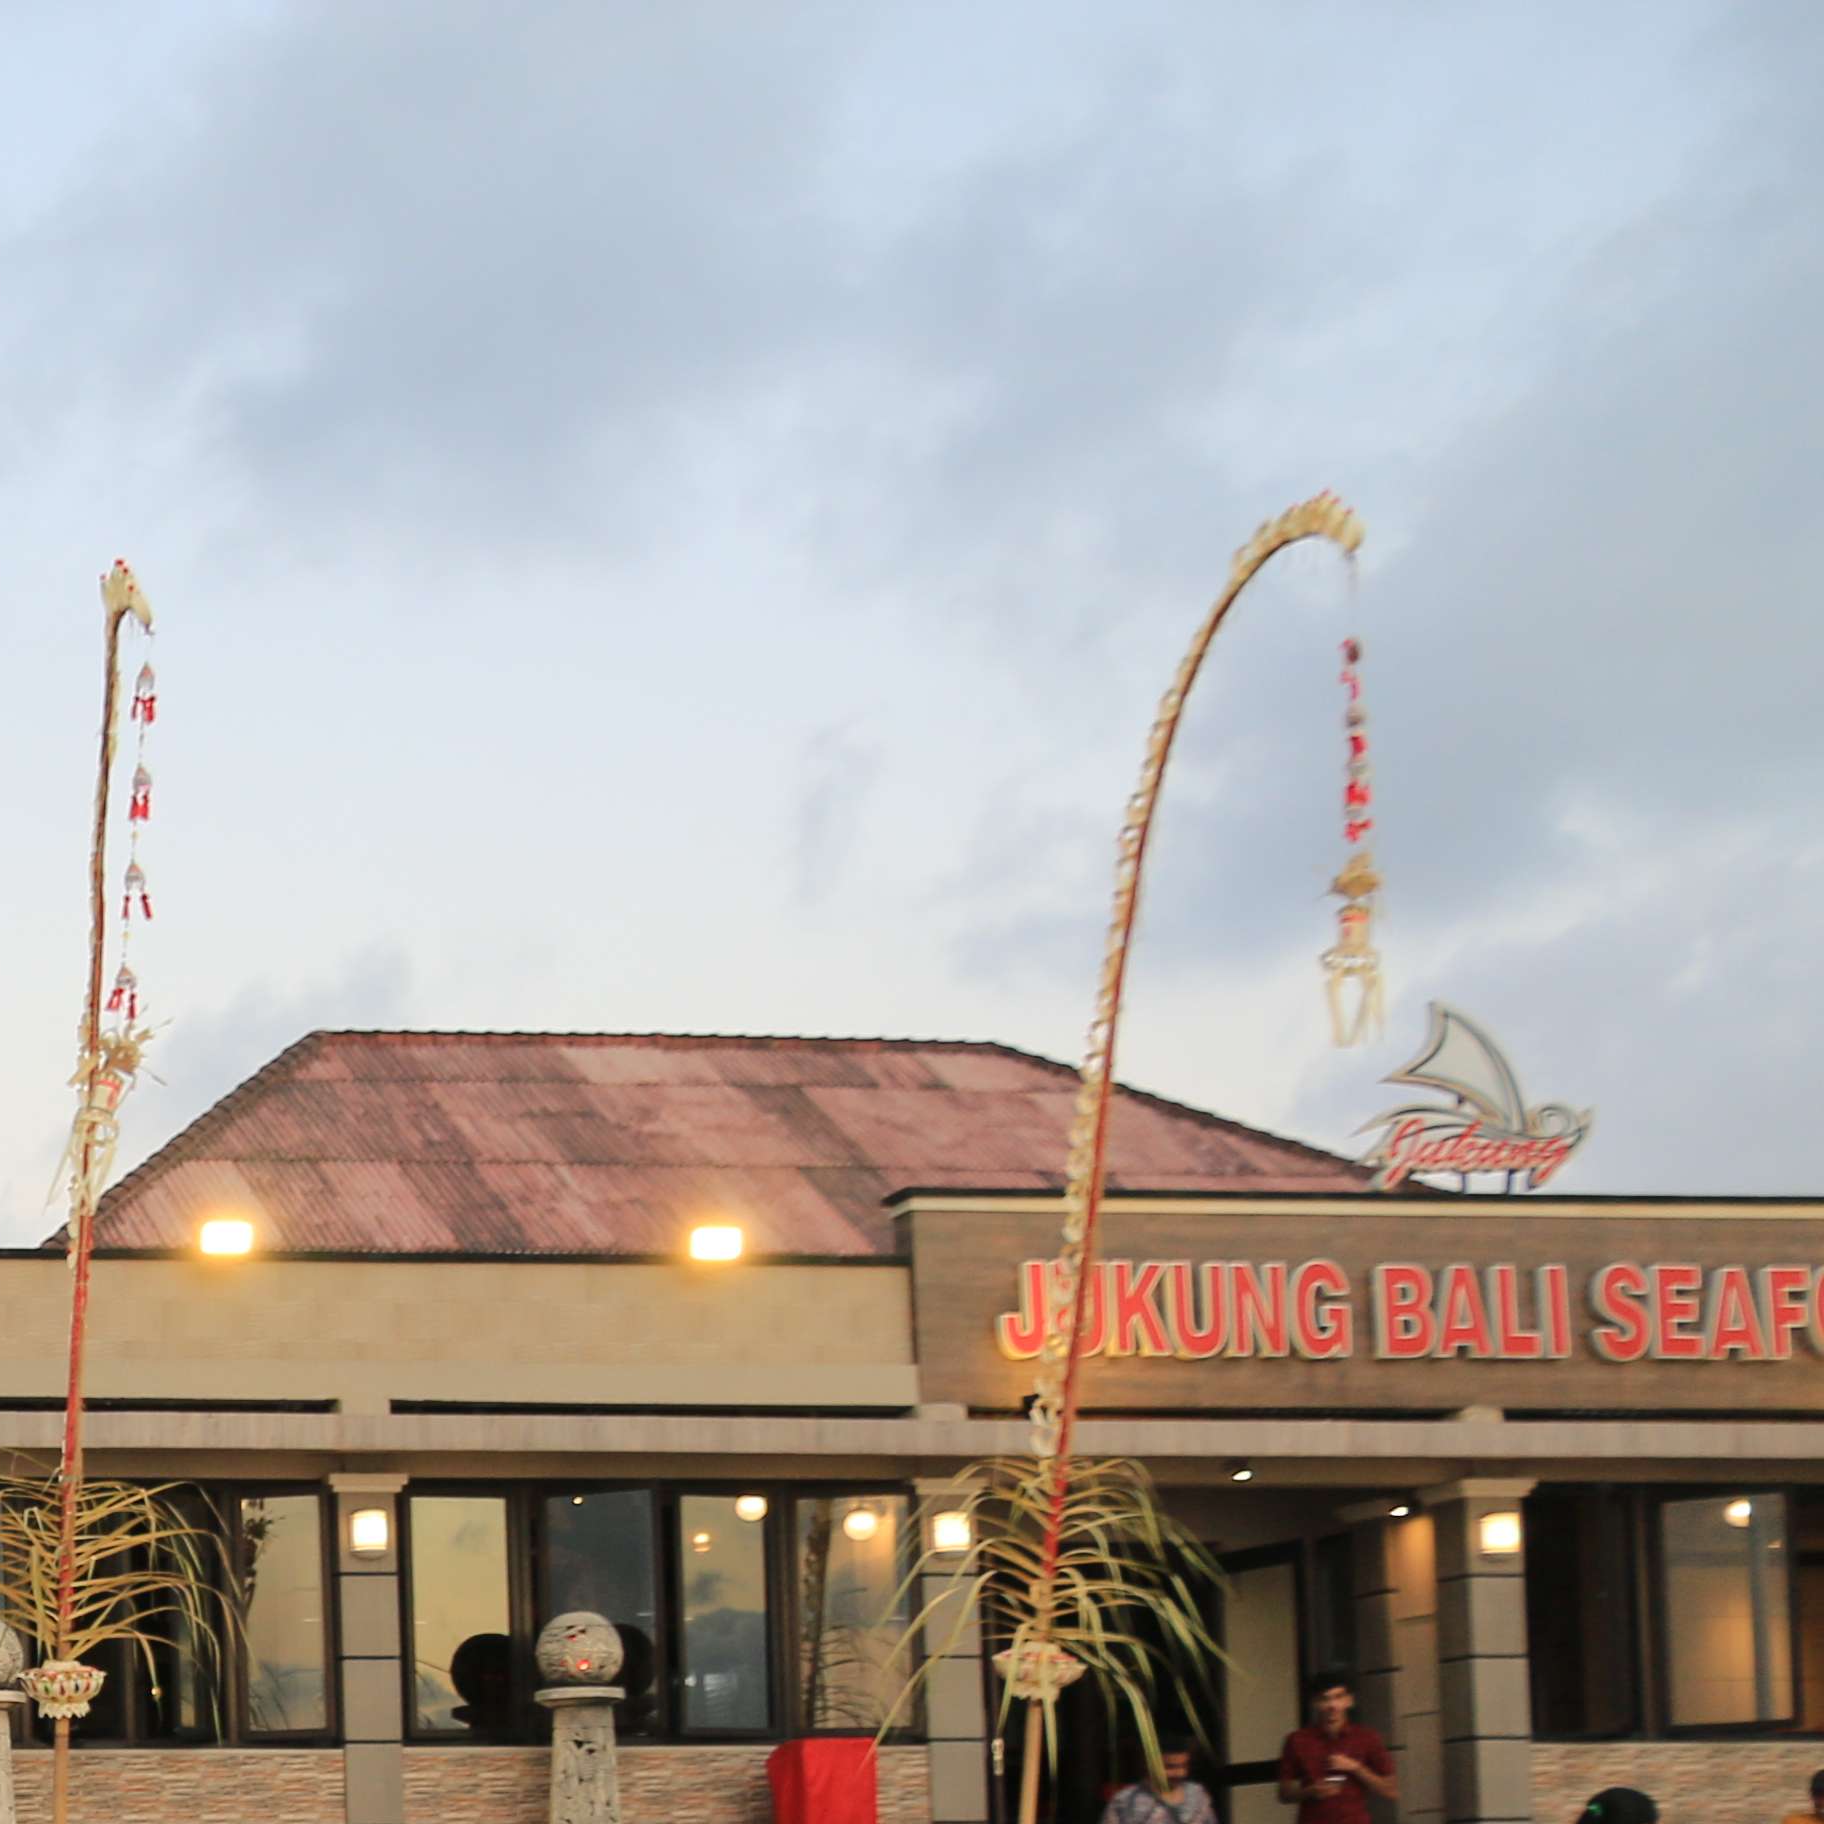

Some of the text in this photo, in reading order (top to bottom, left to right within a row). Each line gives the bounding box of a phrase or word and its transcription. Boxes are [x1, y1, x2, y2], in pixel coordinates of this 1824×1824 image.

[1383, 1117, 1569, 1190] Jukung
[1372, 1262, 1572, 1359] BALI
[1590, 1263, 1824, 1362] SEAF
